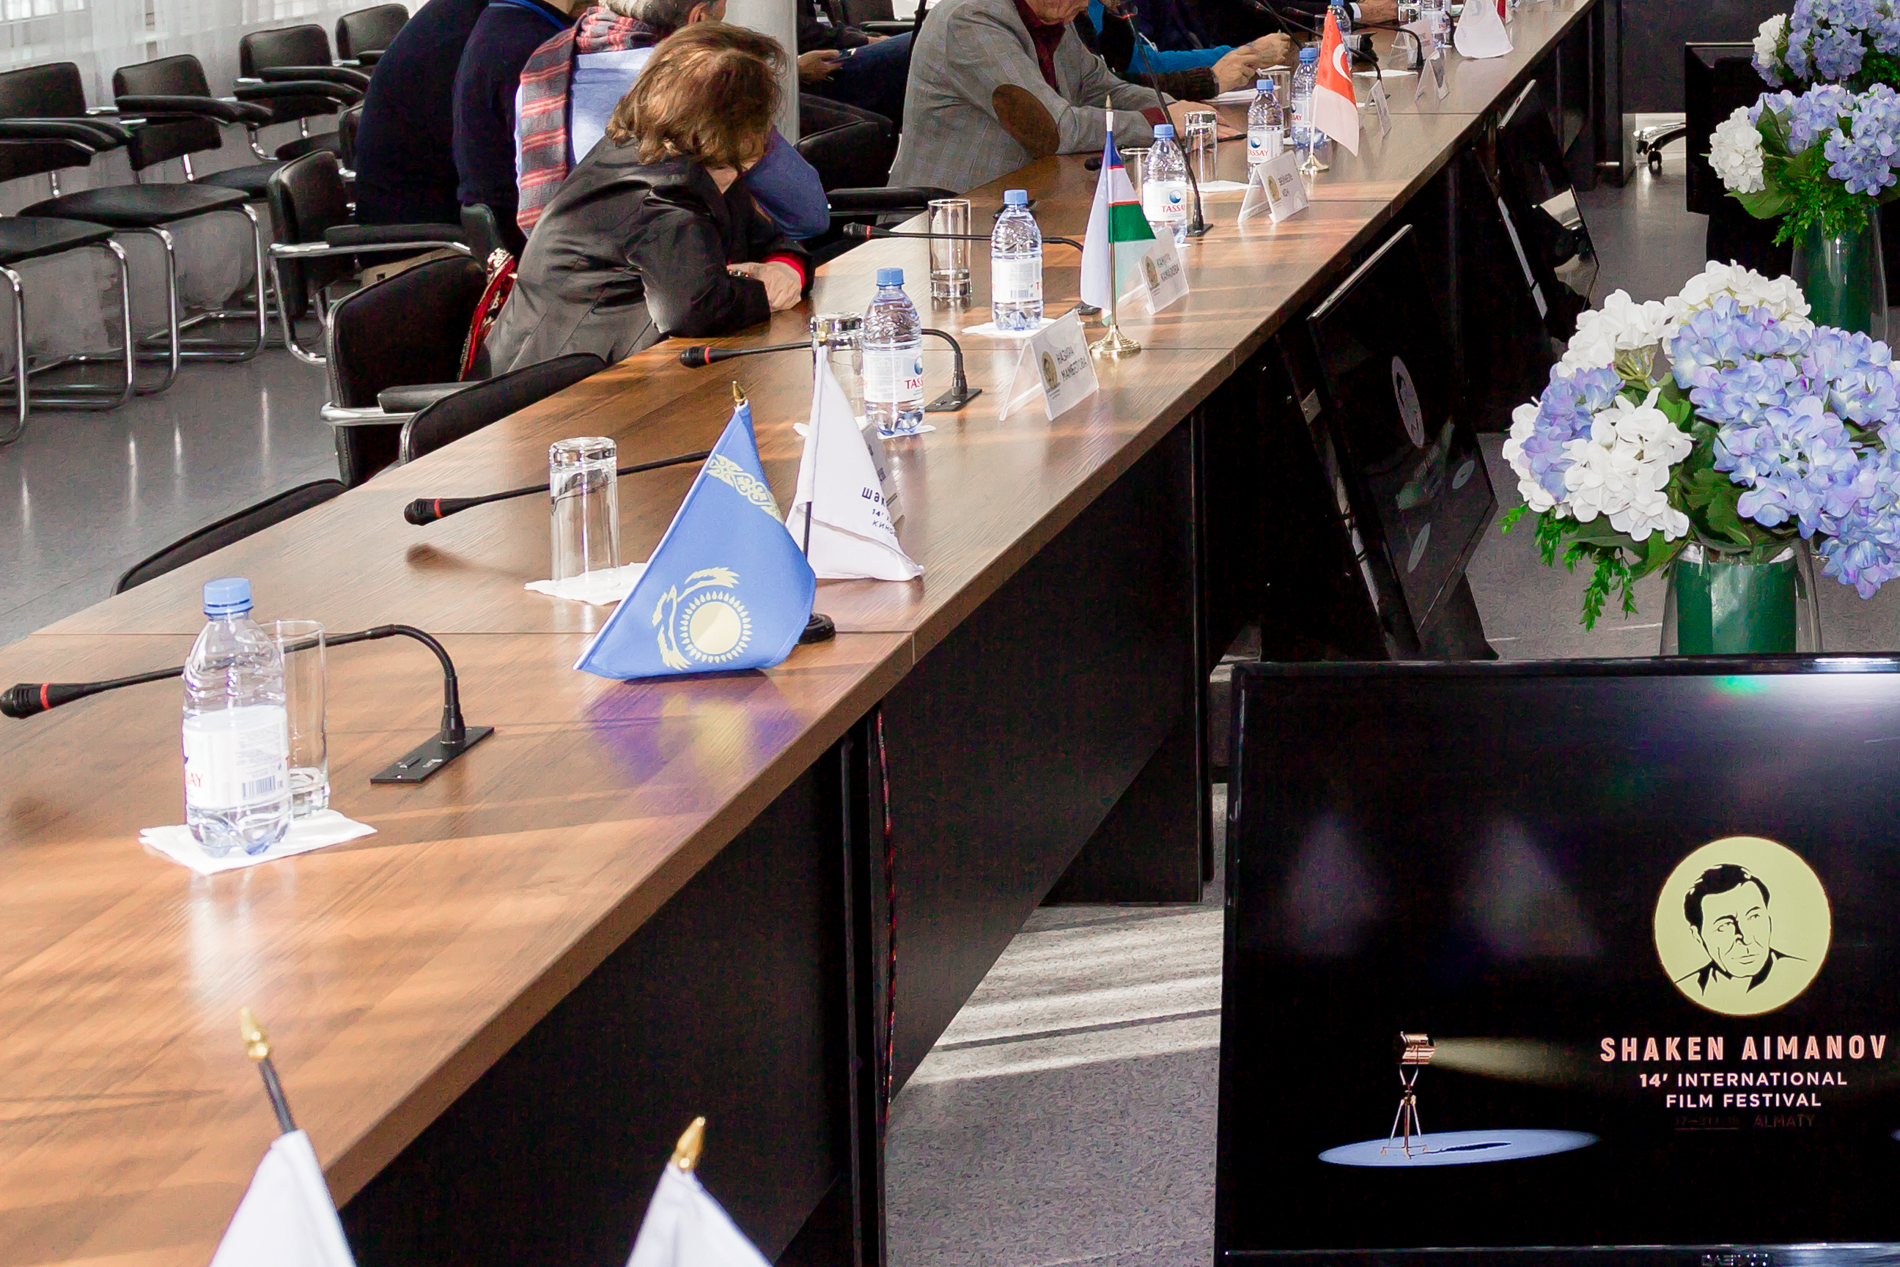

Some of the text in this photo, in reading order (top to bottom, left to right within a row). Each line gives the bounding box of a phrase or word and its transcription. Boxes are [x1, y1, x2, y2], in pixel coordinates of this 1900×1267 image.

[1599, 1035, 1887, 1062] SHAKEN AIMANOV
[1677, 1071, 1848, 1087] INTERNATIONAL
[1665, 1092, 1822, 1108] FILM FESTIVAL
